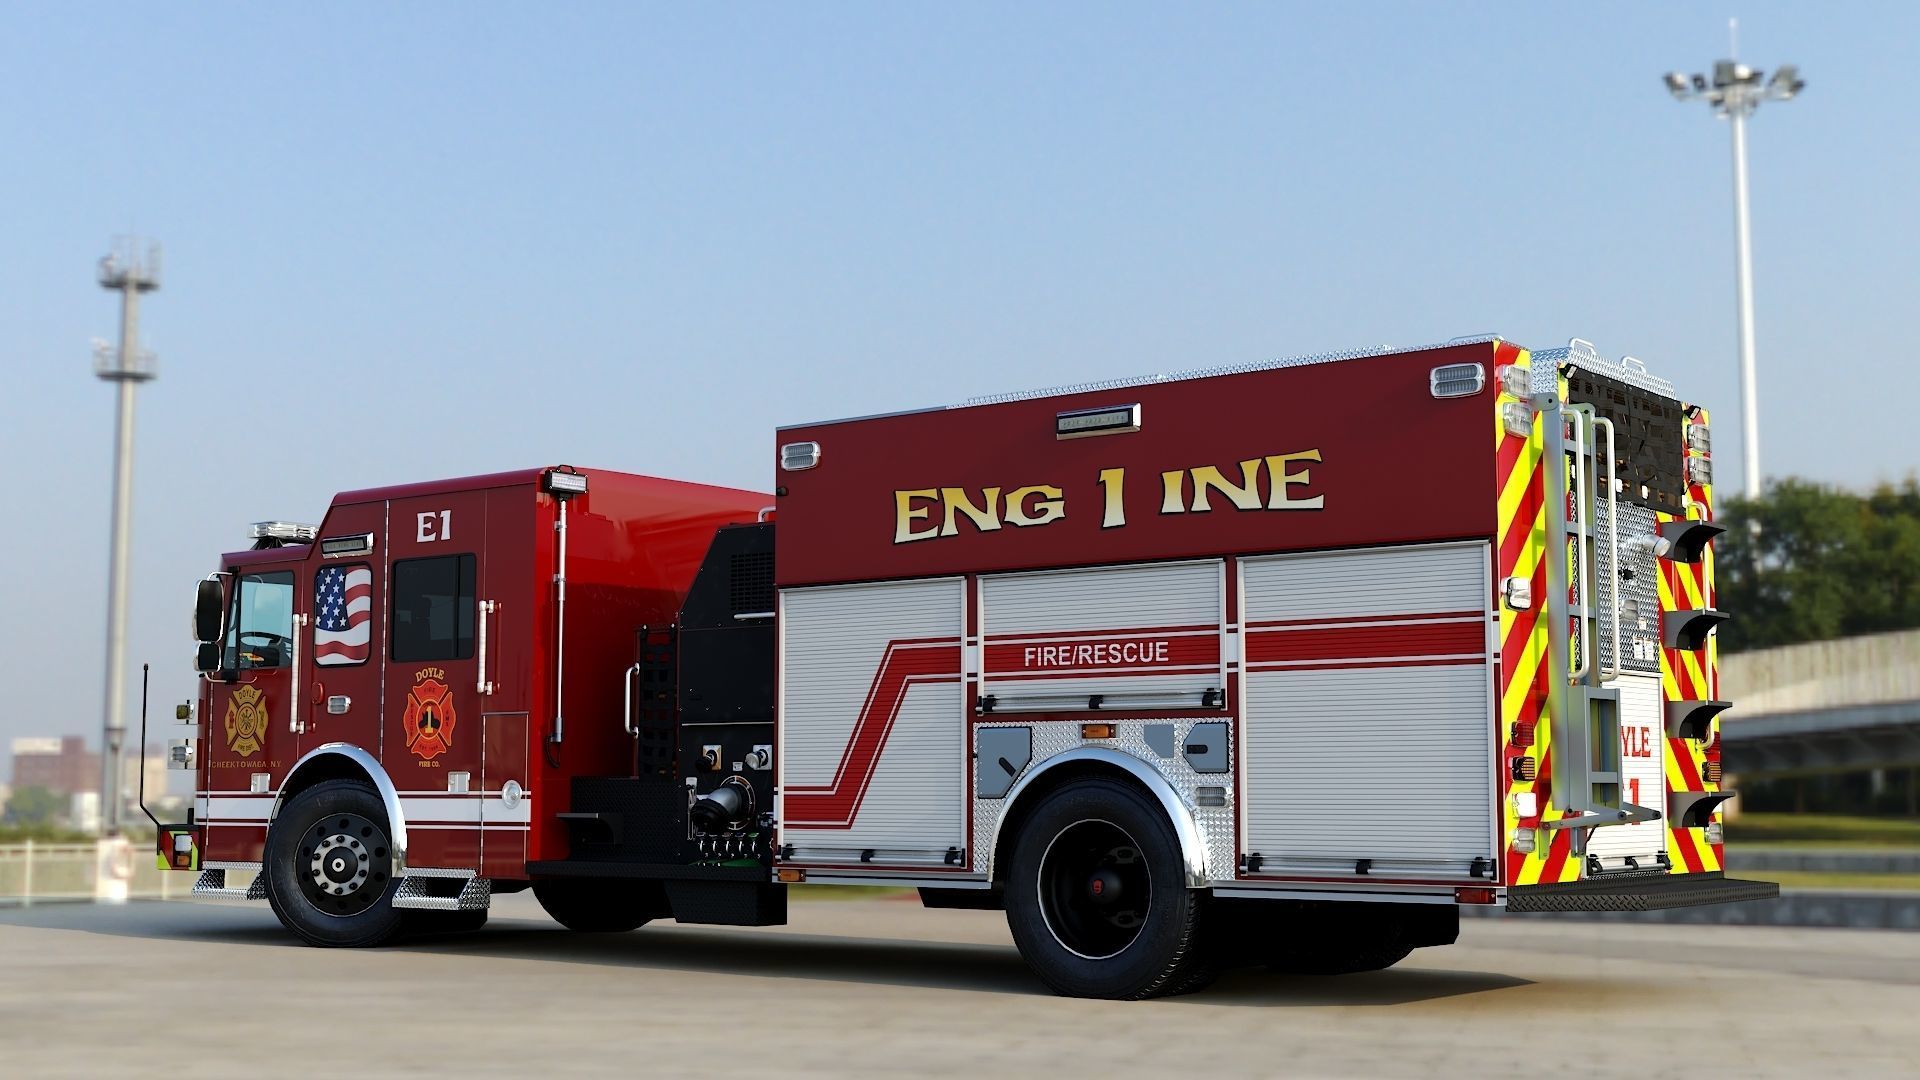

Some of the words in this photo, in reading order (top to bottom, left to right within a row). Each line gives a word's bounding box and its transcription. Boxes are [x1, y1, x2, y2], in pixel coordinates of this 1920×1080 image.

[893, 484, 1066, 545] ENG
[1097, 467, 1127, 528] 1
[1160, 448, 1325, 515] INE
[416, 509, 452, 543] E1
[1024, 641, 1169, 667] FIRE/RESCUE
[416, 667, 444, 682] DOYLE
[238, 689, 257, 700] DOYLE
[425, 706, 434, 734] 1
[1620, 726, 1651, 757] YLE
